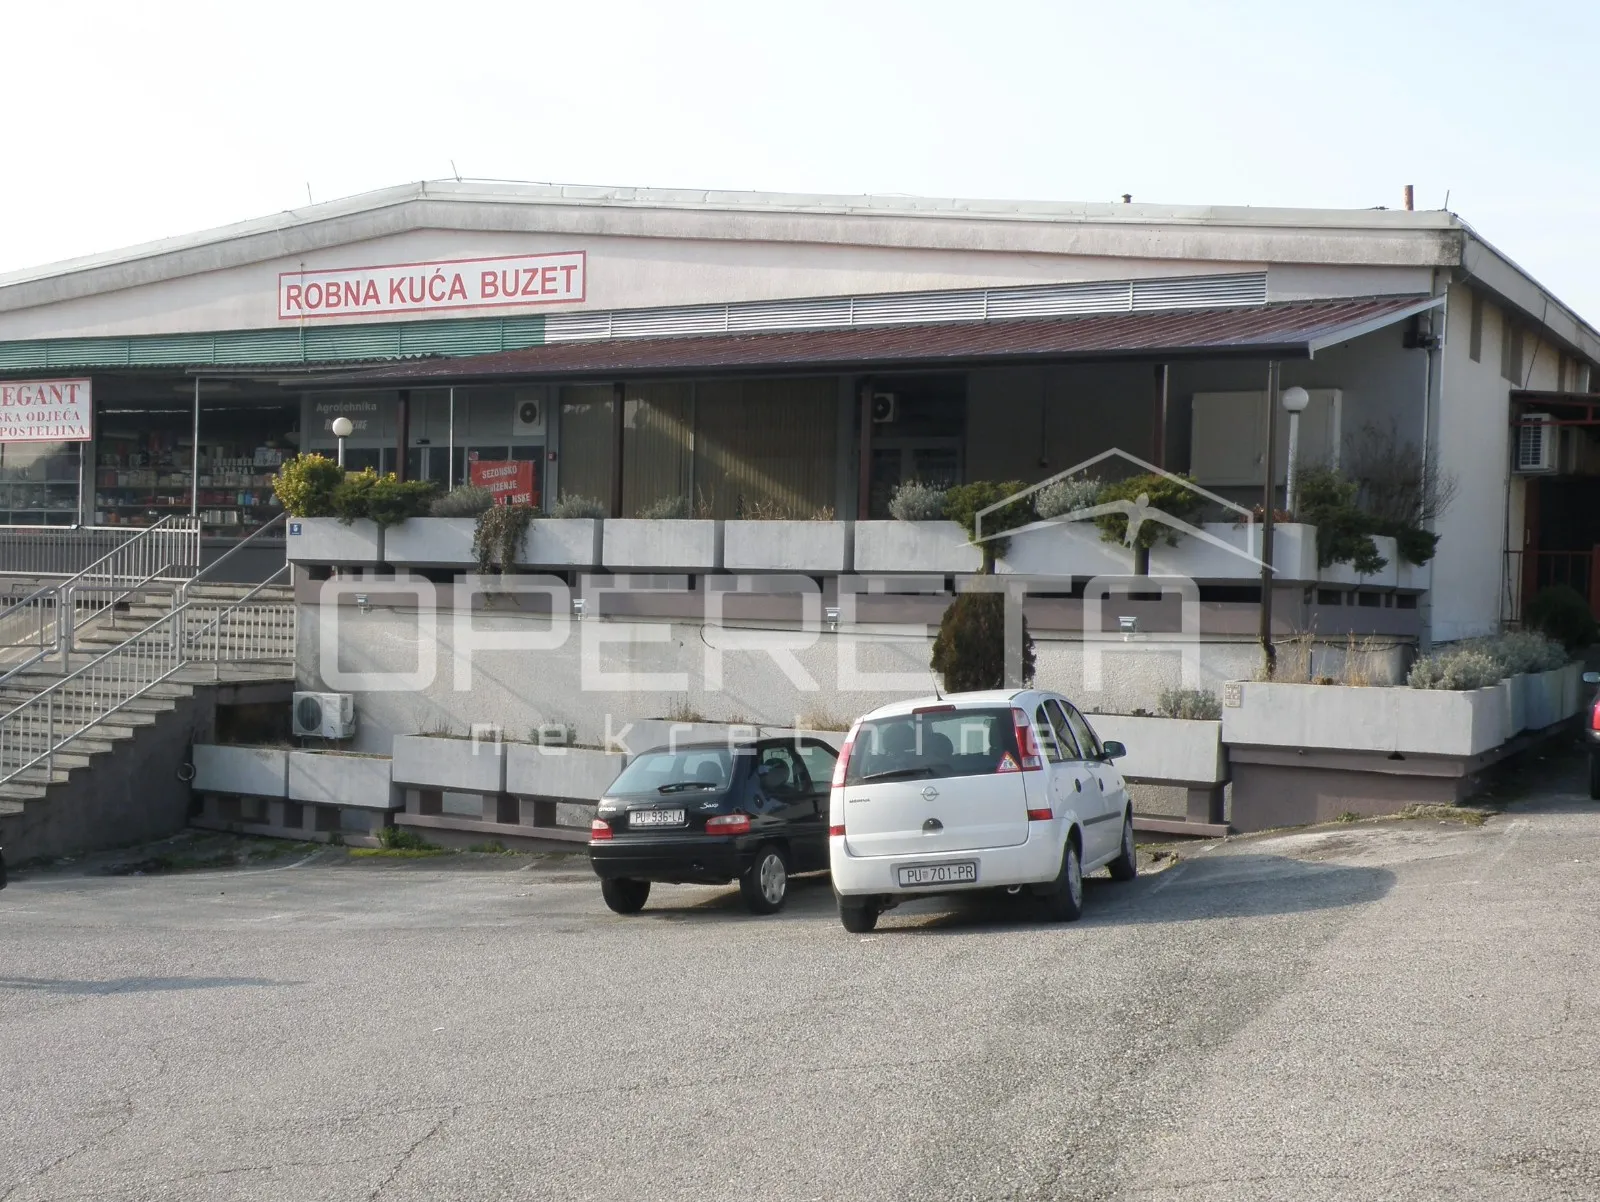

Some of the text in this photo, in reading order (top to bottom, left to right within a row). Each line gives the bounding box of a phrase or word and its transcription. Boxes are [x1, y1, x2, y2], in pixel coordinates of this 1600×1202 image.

[286, 264, 578, 310] ROBNA KUĆA BUZET
[1, 384, 81, 407] EGANT
[316, 400, 377, 414] Agrotehnika
[0, 424, 85, 437] POSTELJINA
[482, 465, 518, 479] SEZONSKO
[635, 810, 684, 823] PU 936-LA
[907, 865, 974, 883] PU 701-PR
